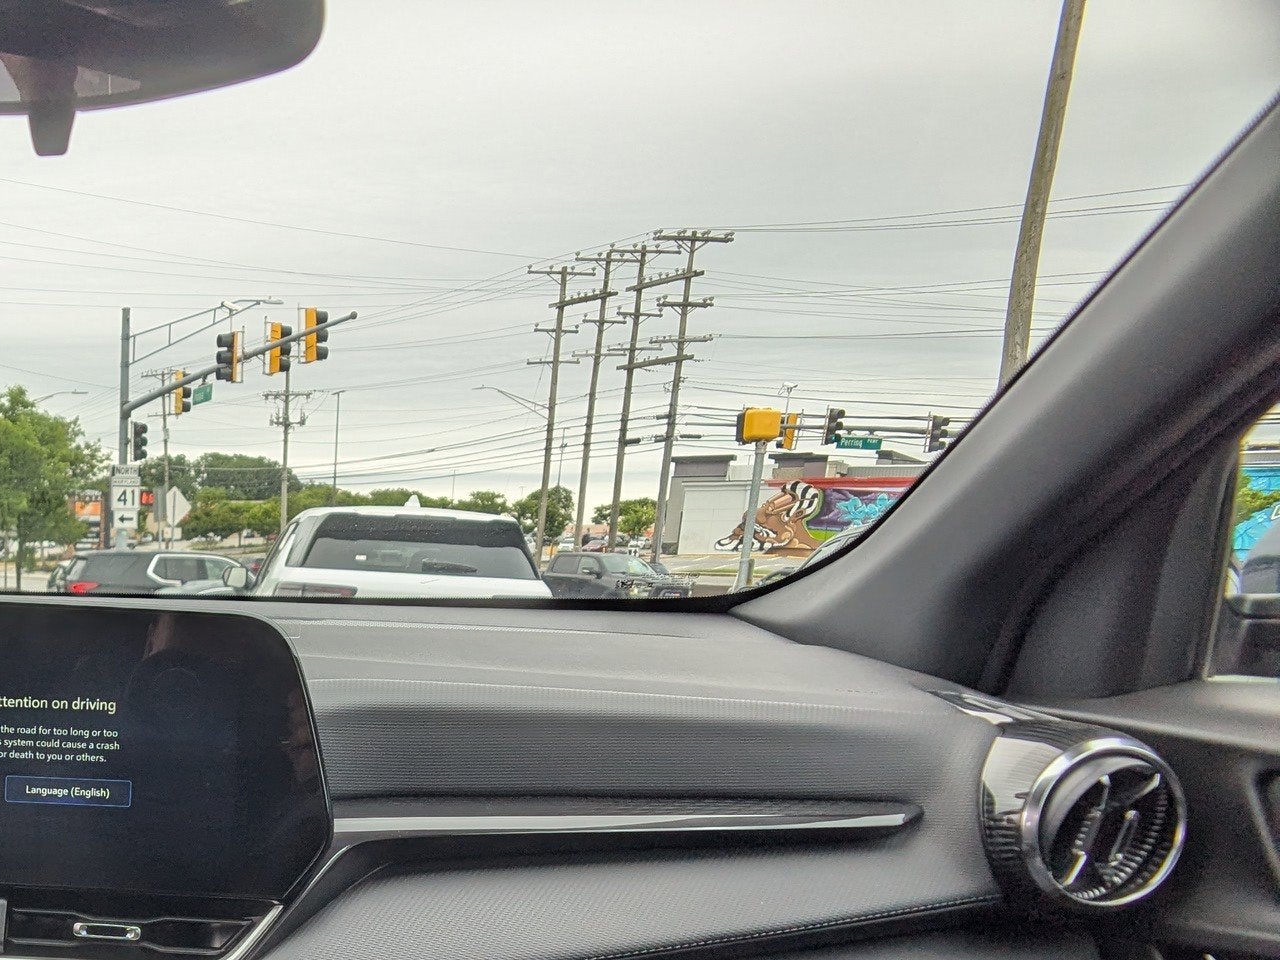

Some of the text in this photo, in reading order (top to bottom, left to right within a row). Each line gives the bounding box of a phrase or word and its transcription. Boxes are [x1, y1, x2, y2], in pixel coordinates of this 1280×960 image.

[840, 437, 862, 448] Perring
[117, 488, 135, 506] 41
[51, 699, 68, 710] on
[72, 697, 117, 715] driving
[0, 725, 15, 733] the
[17, 726, 37, 735] road
[39, 725, 51, 735] for
[53, 727, 68, 736] too
[70, 727, 90, 739] long
[103, 728, 119, 738] too
[4, 739, 34, 749] system
[36, 739, 60, 748] could
[62, 741, 87, 749] cause
[96, 741, 120, 750] crash
[9, 750, 34, 759] death
[36, 751, 46, 760] to
[46, 753, 63, 763] you
[64, 753, 75, 761] or
[76, 753, 107, 762] others.
[26, 785, 111, 799] Language (English)
